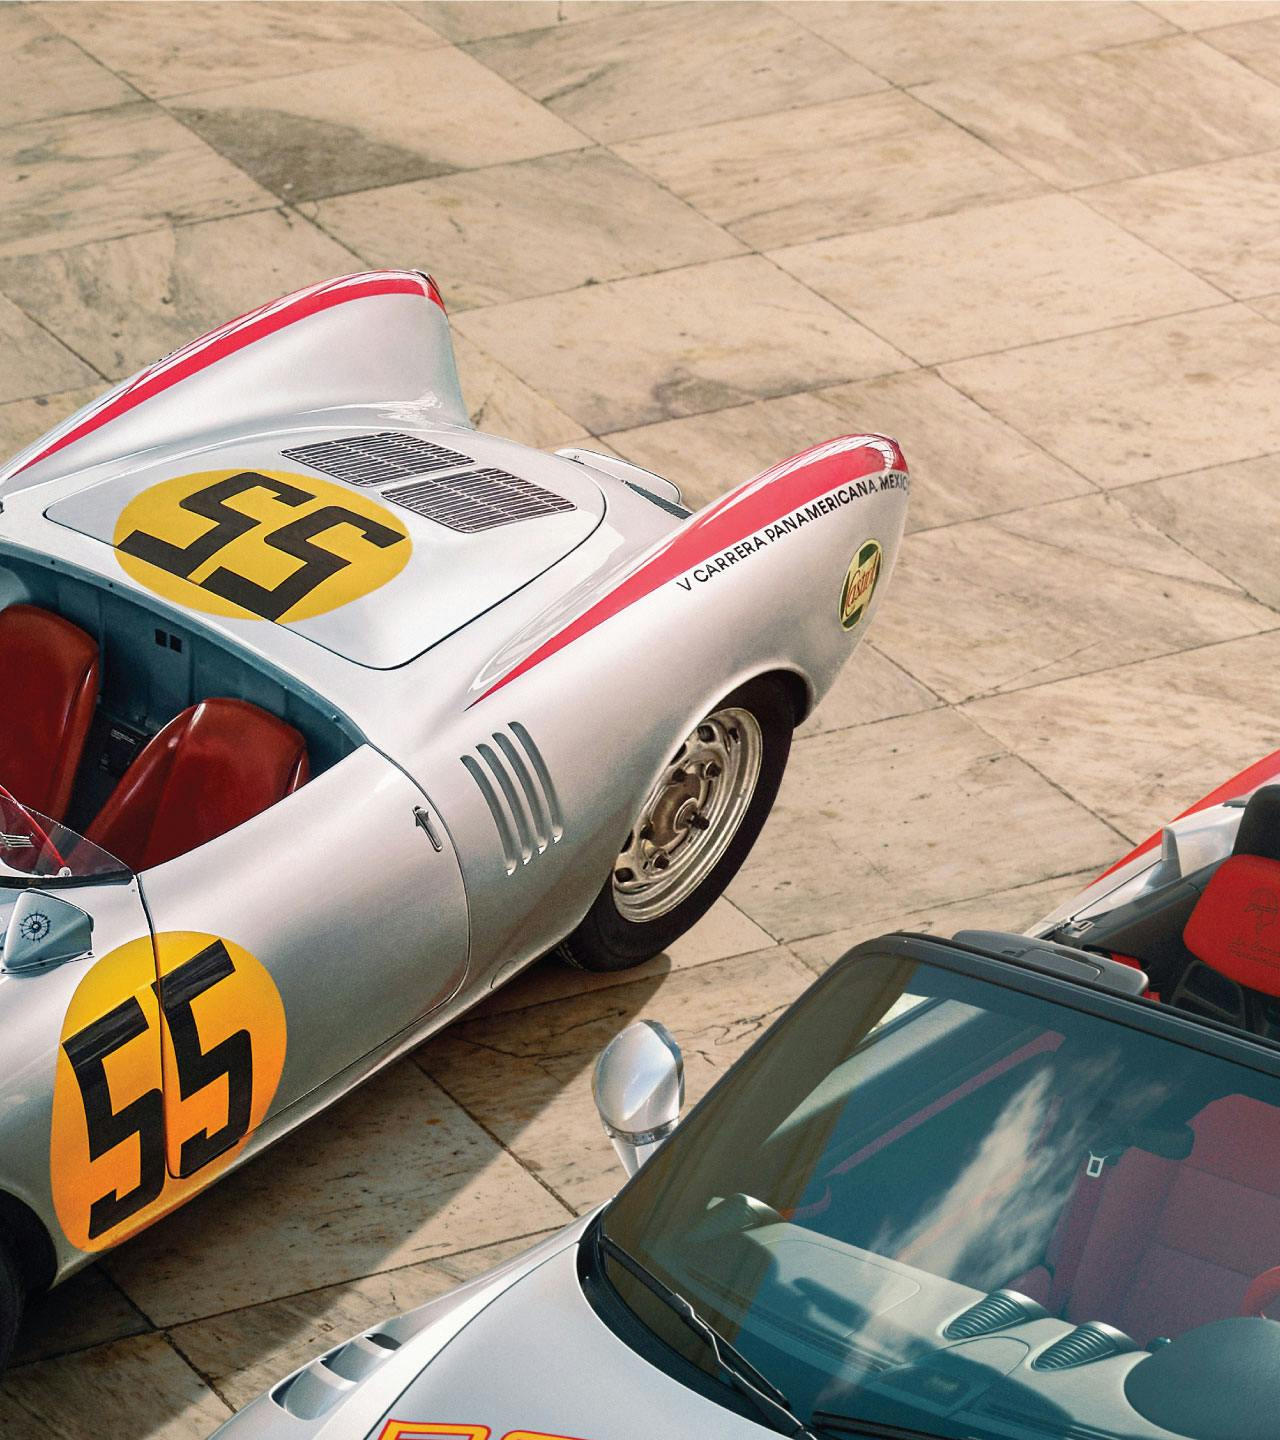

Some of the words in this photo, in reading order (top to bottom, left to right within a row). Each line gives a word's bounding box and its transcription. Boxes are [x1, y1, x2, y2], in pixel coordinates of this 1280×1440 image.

[117, 472, 407, 623] 55
[676, 577, 693, 592] V
[693, 536, 768, 582] CARRERA
[765, 479, 879, 541] PANAMERICANA
[61, 939, 253, 1240] 55
